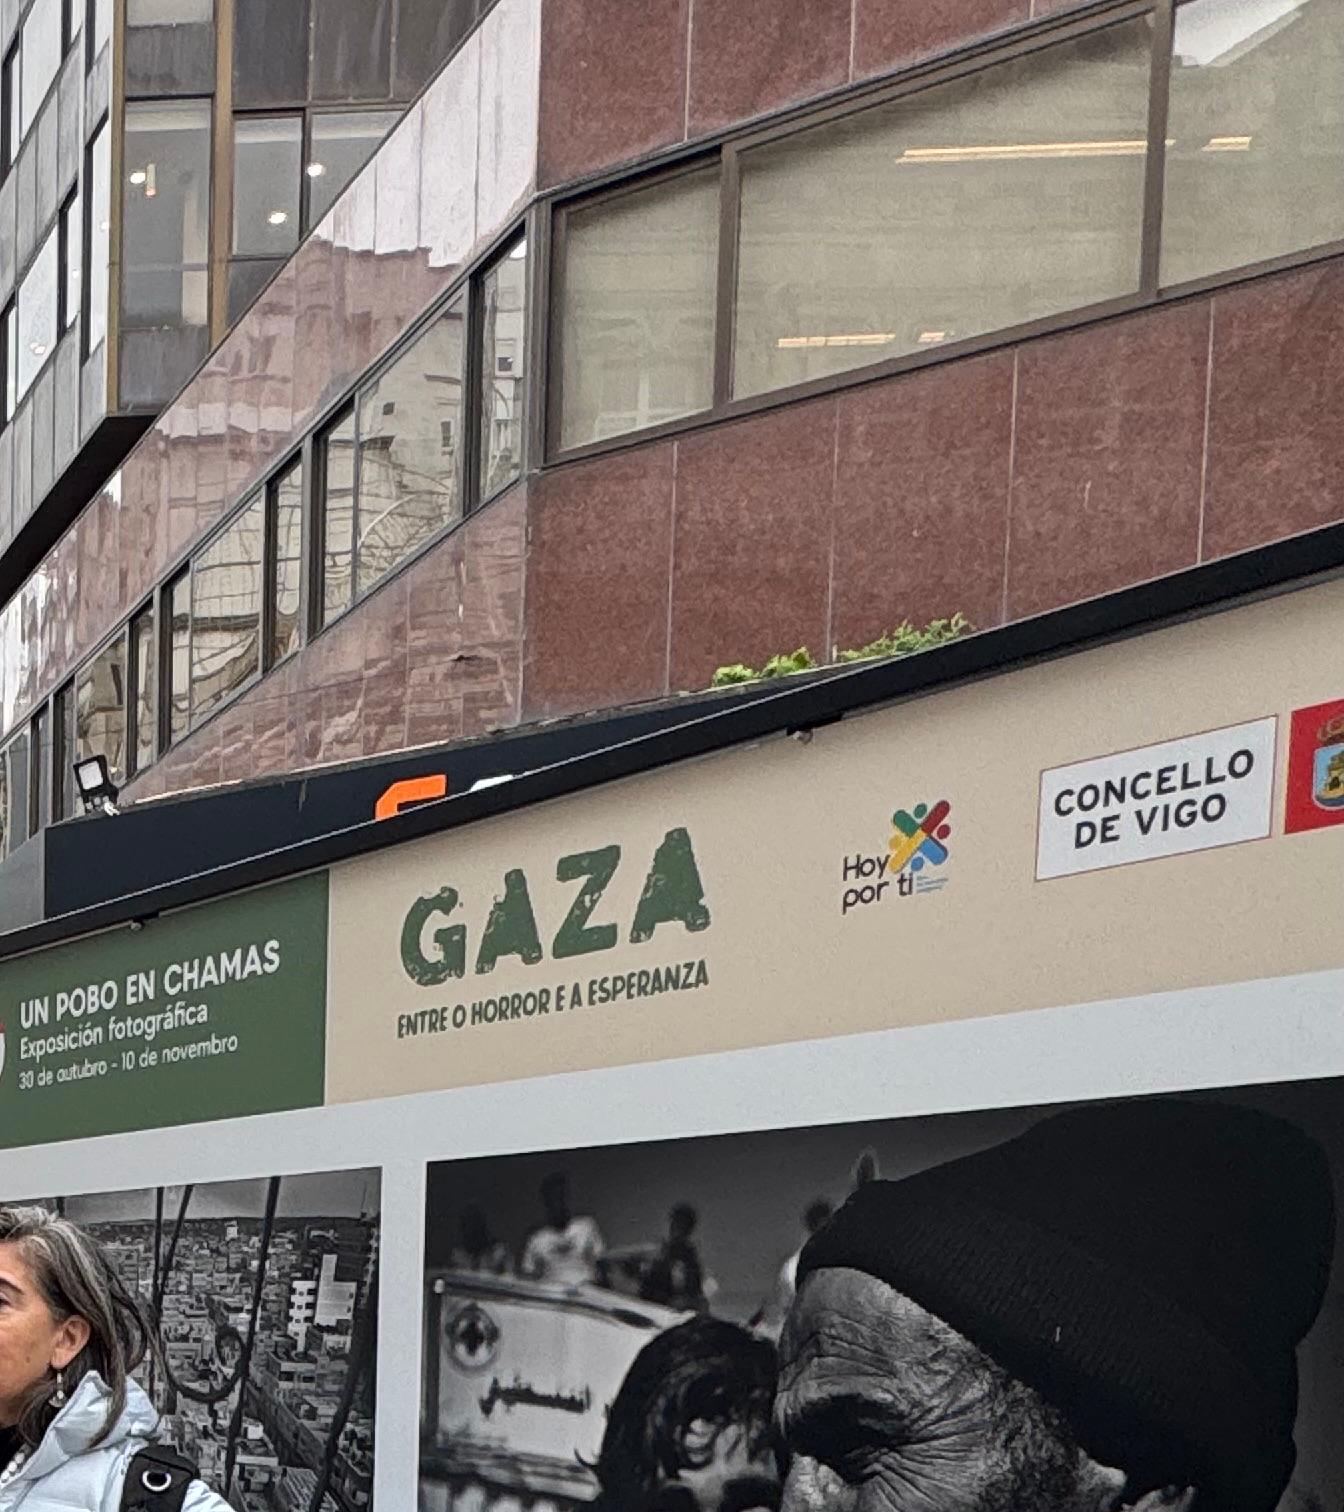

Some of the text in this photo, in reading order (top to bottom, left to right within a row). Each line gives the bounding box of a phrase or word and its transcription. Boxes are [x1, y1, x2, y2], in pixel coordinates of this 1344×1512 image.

[1054, 749, 1254, 817] CONCELLO
[1074, 793, 1227, 850] DE VIGO
[841, 881, 890, 915] por
[897, 872, 913, 897] ti
[842, 853, 890, 882] Hoy
[400, 826, 712, 988] GAZA
[20, 939, 281, 1029] UN POBO EN CHAMAS
[397, 959, 710, 1039] ENTRE O HORROR E A ESPERANZA
[18, 1070, 34, 1090] 30
[37, 1065, 53, 1086] de
[56, 1058, 108, 1083] outubro
[121, 1051, 136, 1072] 10
[138, 1047, 158, 1069] de
[162, 1033, 239, 1064] novembro
[20, 1001, 208, 1063] Exposición fotográfica
